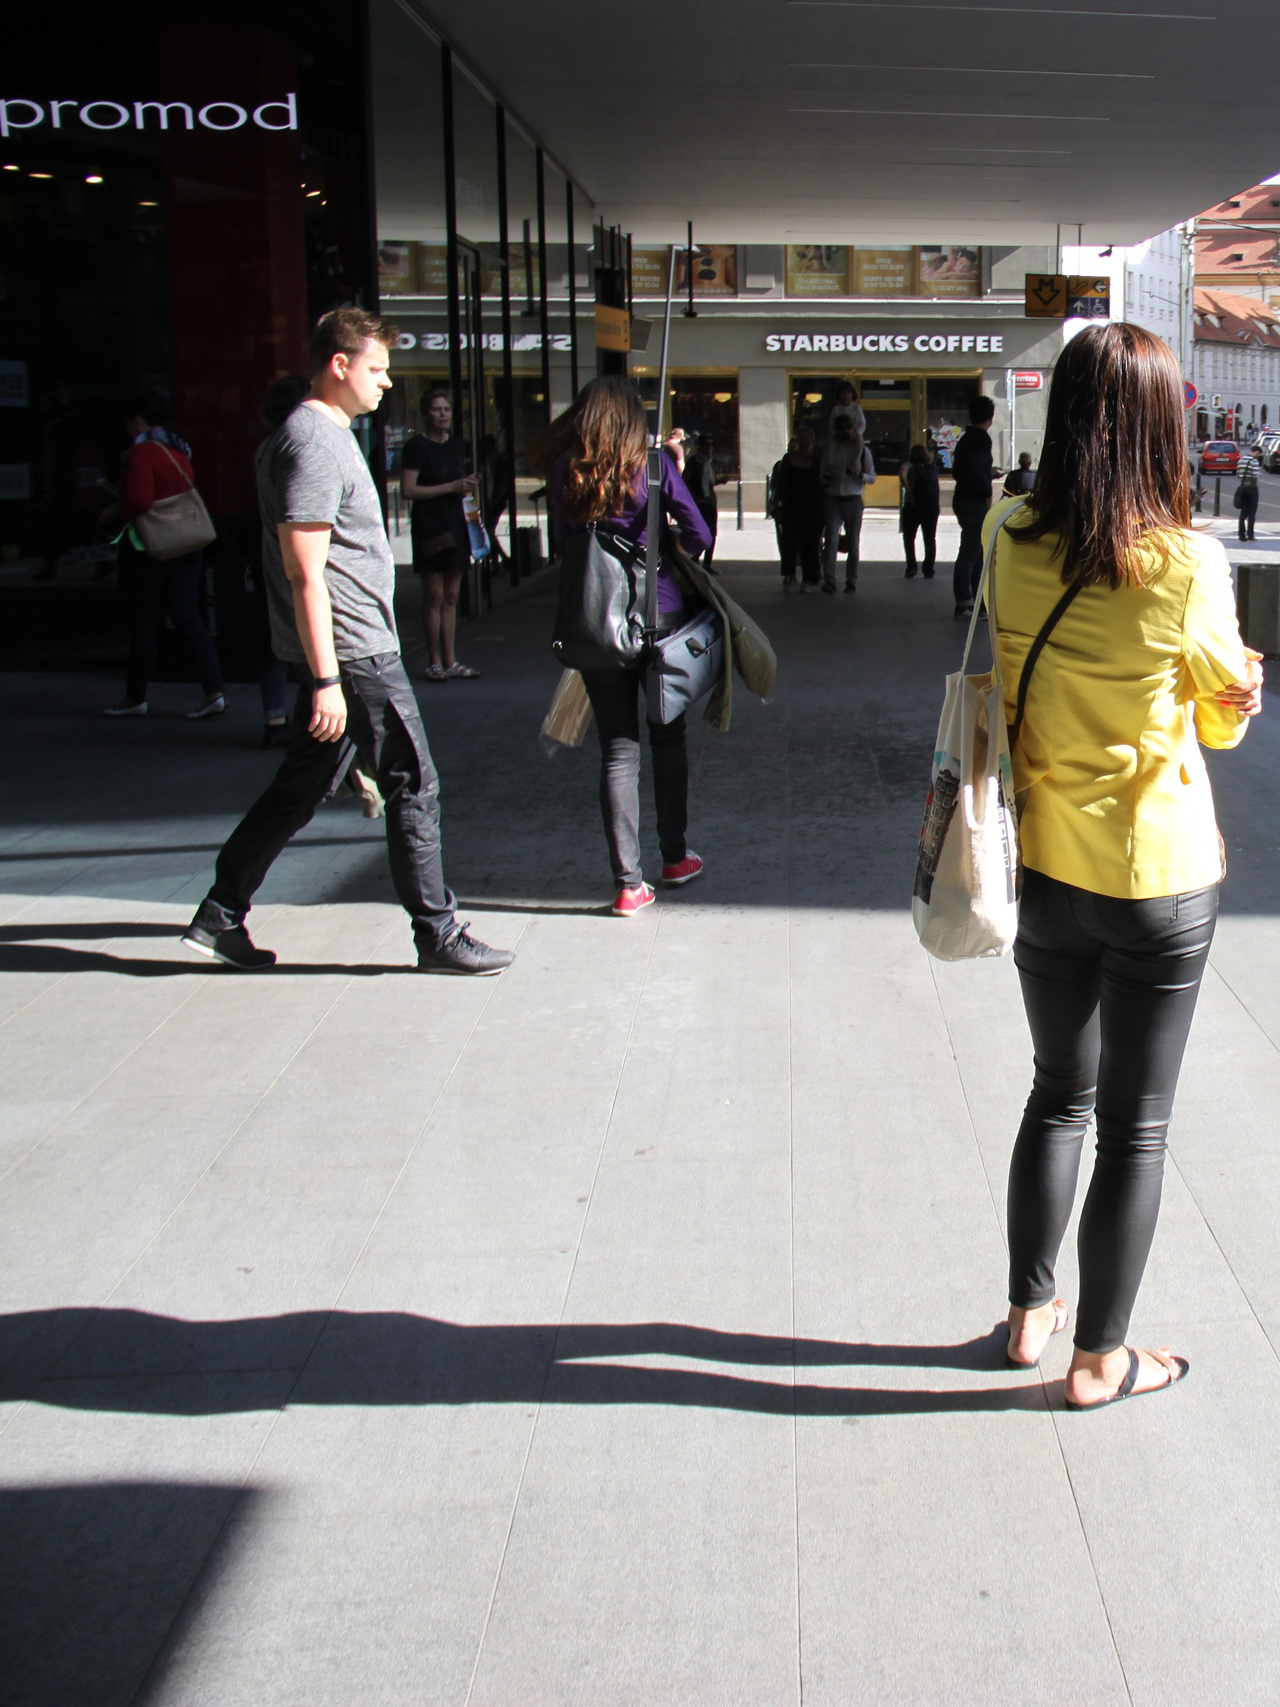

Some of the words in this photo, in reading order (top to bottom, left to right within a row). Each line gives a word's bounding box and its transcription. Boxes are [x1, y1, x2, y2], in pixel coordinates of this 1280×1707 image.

[0, 92, 298, 137] promod
[766, 334, 909, 352] STARBUCKS
[914, 335, 1004, 352] COFFEE
